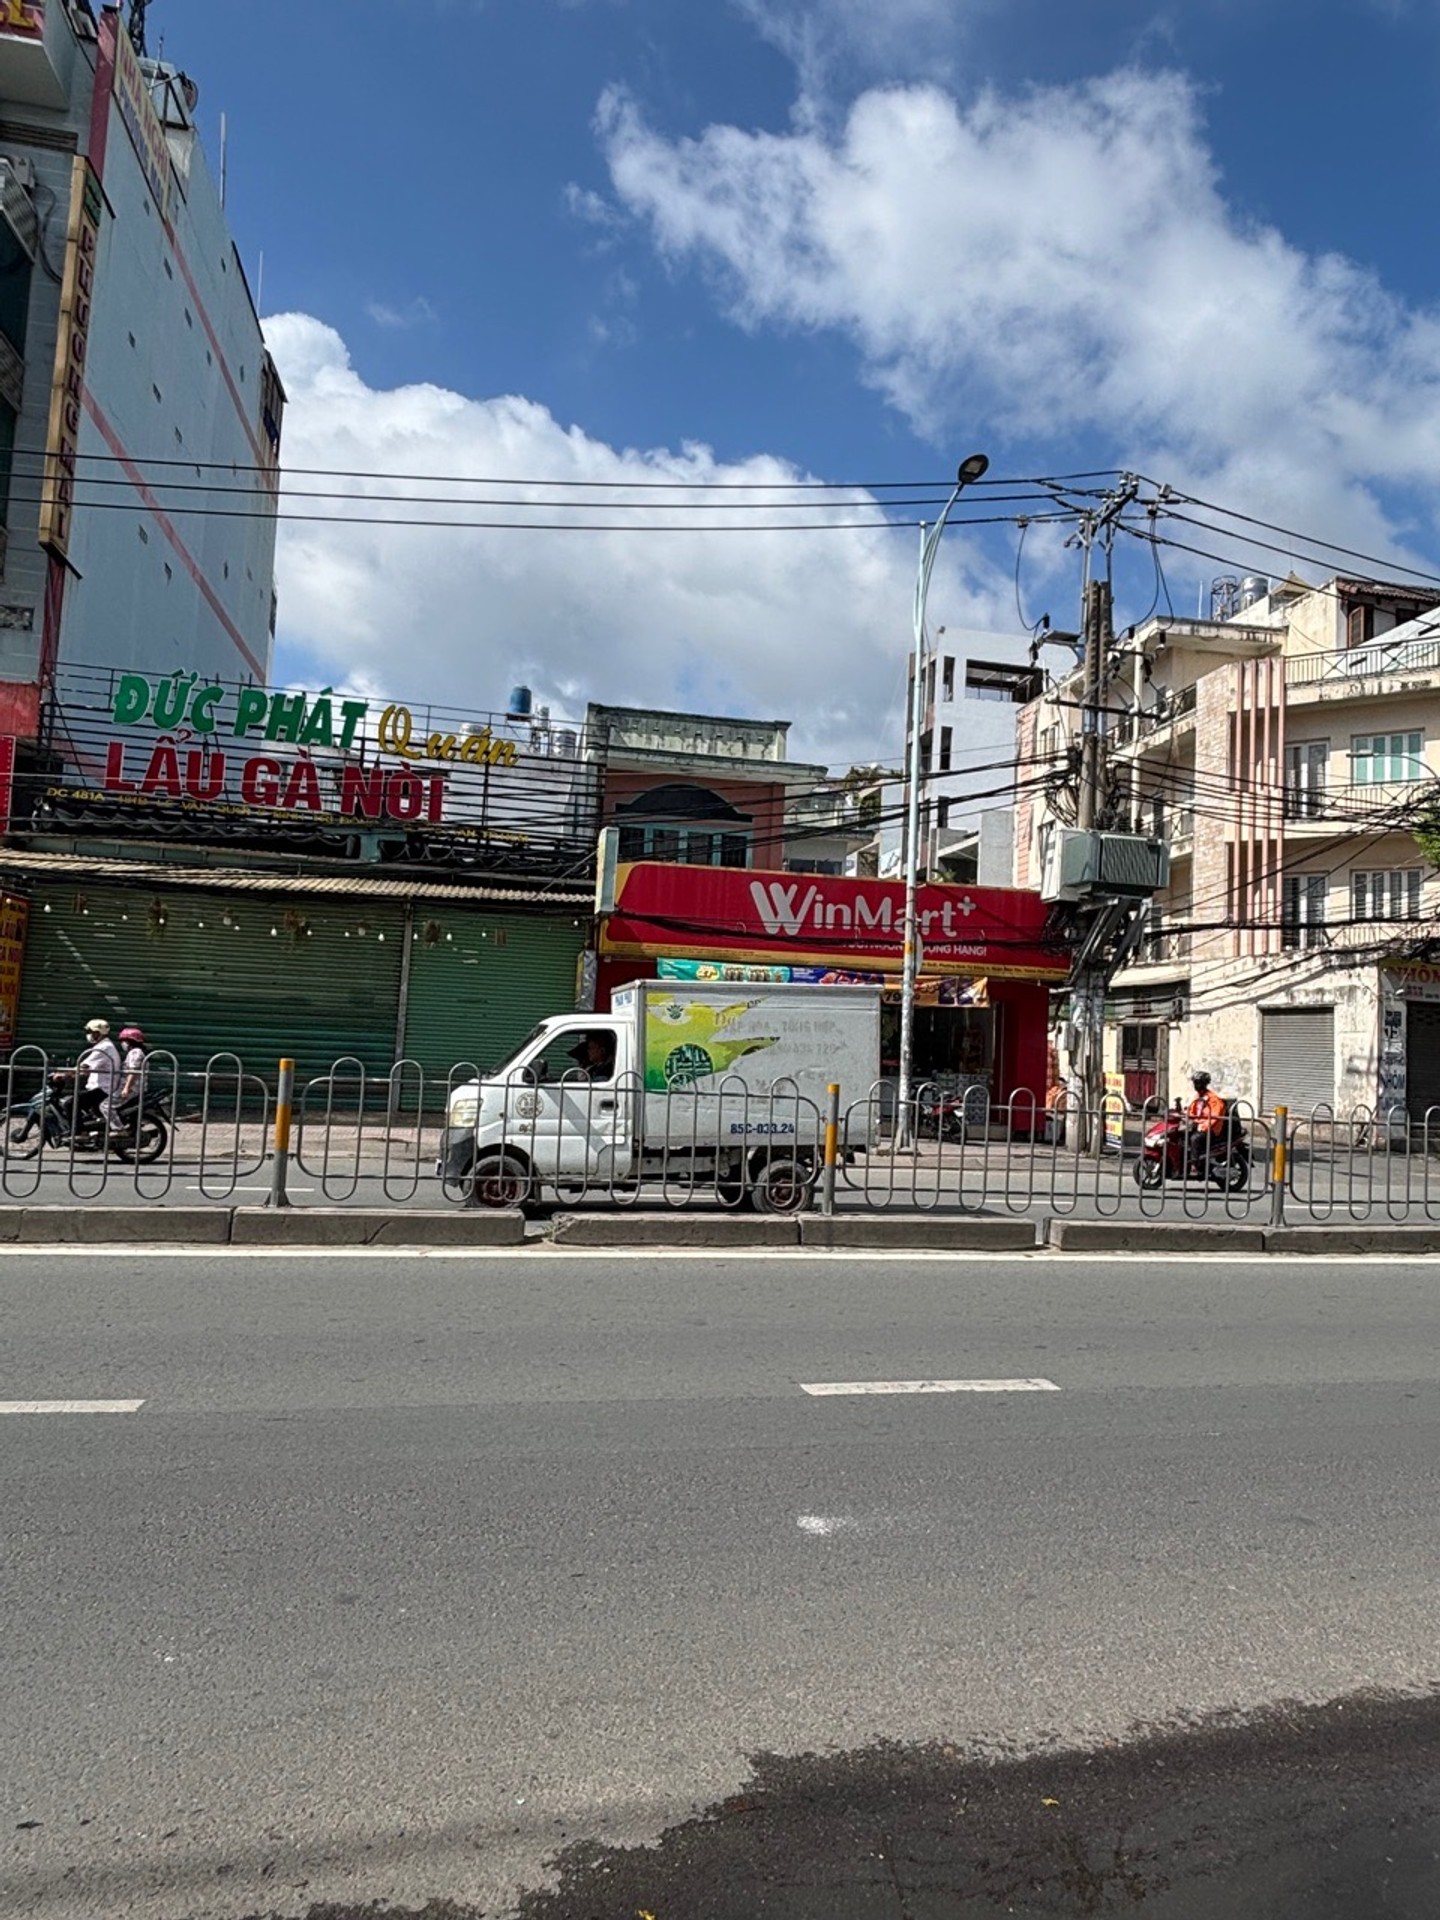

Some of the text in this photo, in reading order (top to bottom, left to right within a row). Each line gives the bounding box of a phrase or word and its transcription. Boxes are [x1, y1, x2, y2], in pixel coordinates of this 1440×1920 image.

[112, 667, 521, 767] ĐỨC PHÁT Quán
[103, 728, 445, 824] LẨU GÀ NÒI
